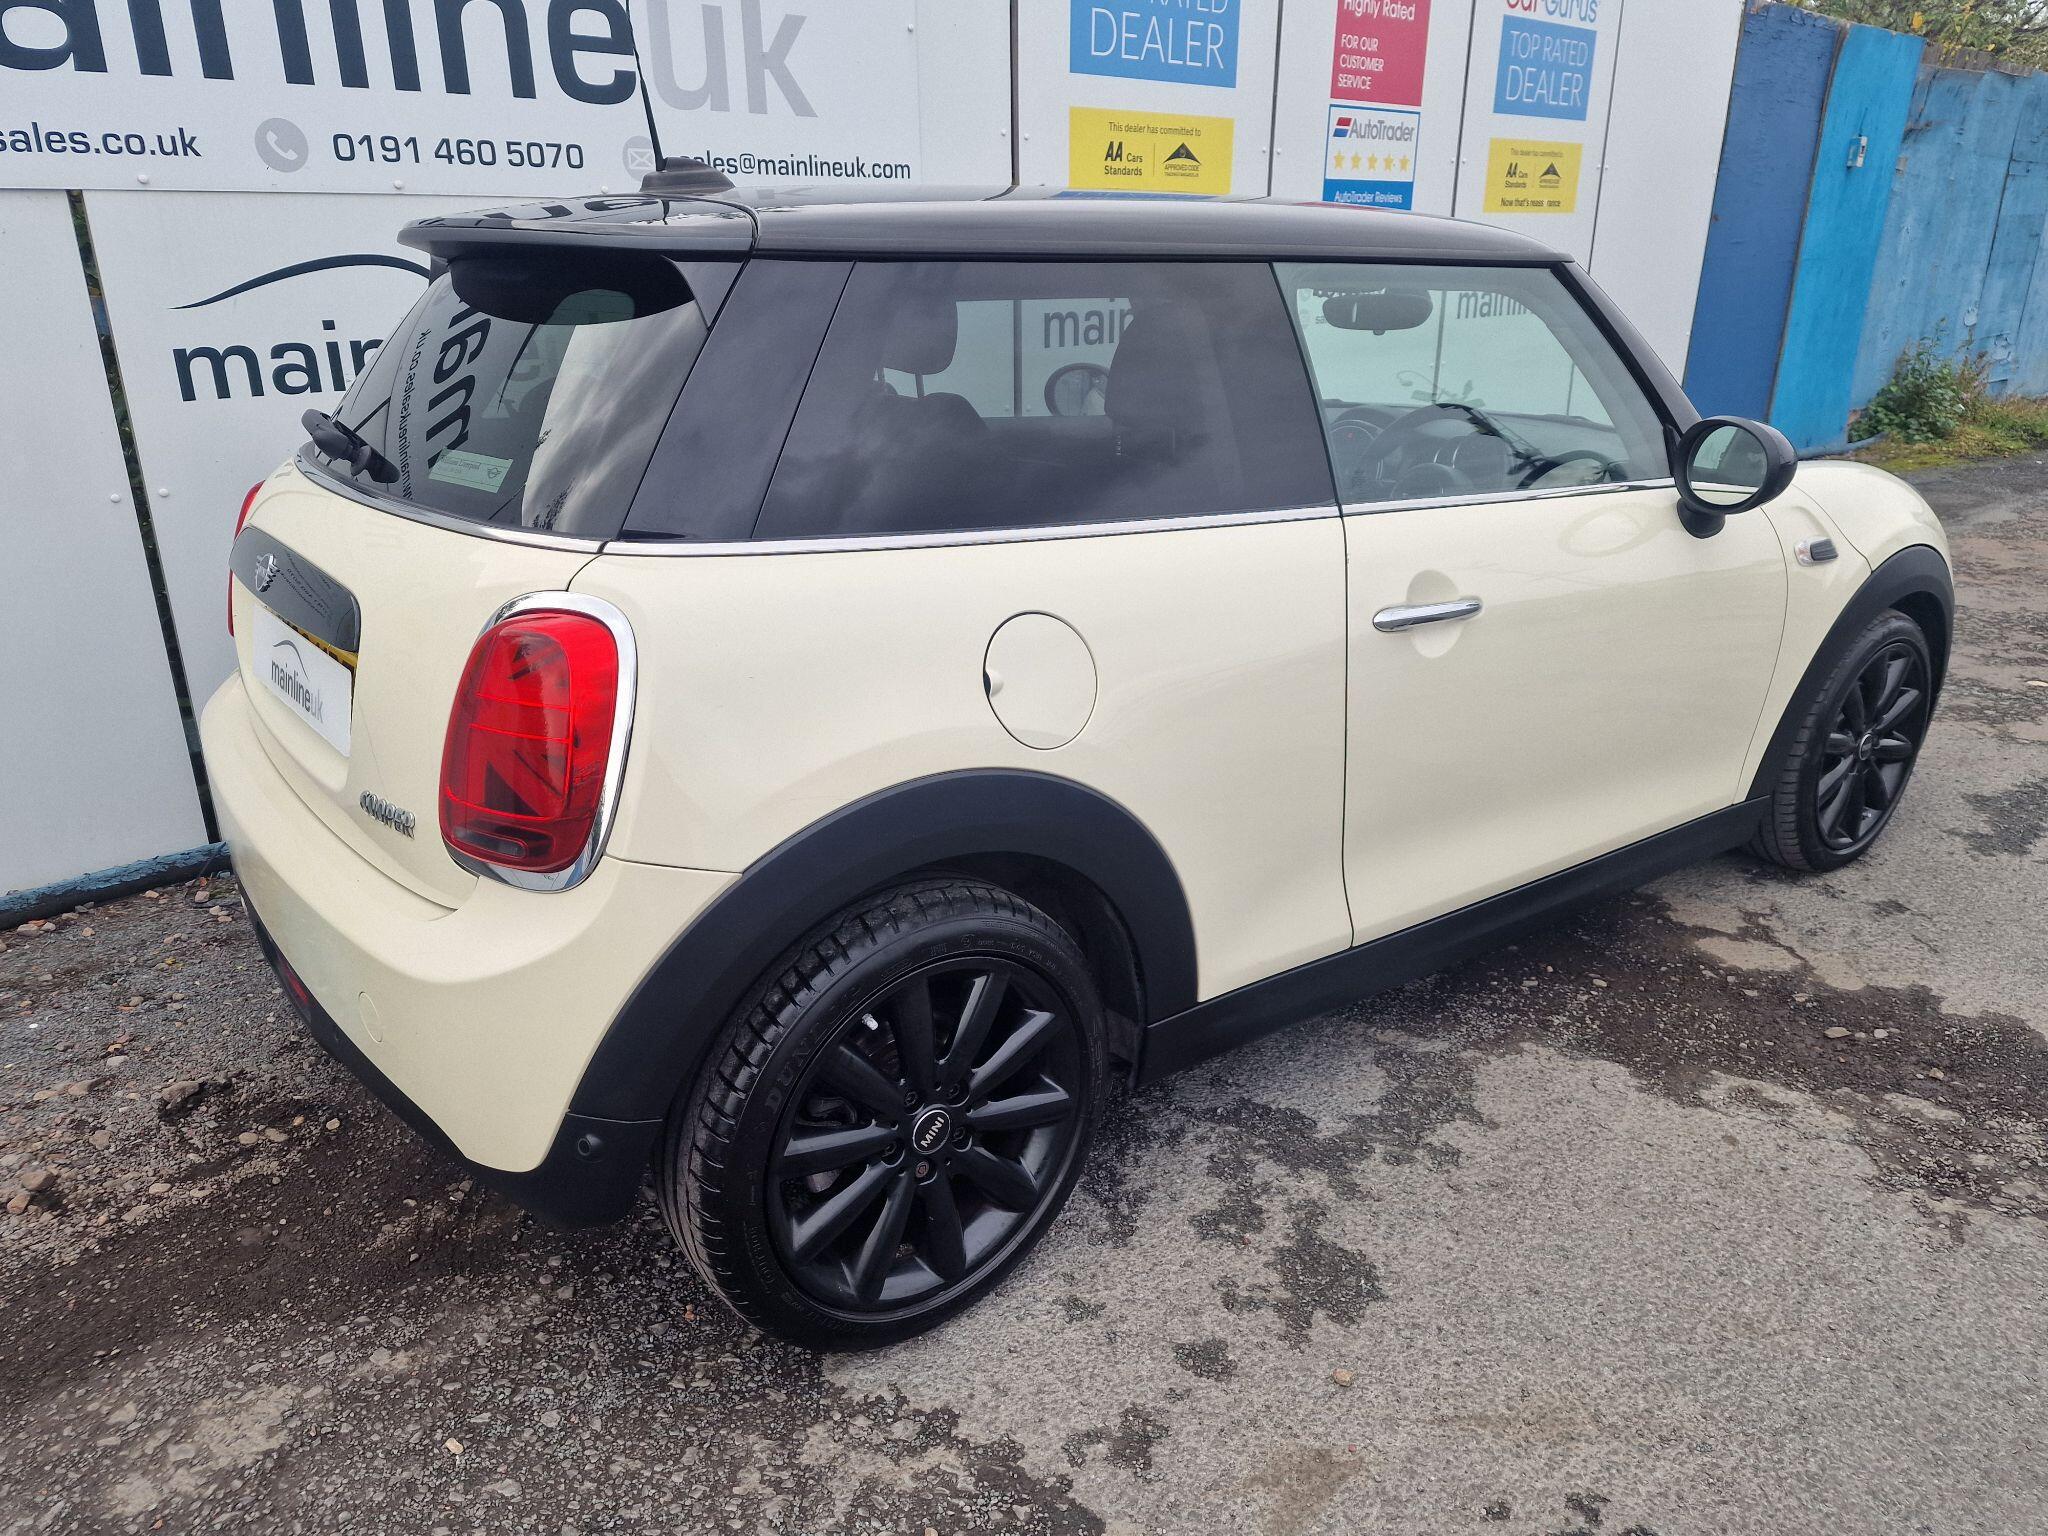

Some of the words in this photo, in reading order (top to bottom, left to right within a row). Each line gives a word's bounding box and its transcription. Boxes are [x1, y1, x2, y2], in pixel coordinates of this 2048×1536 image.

[1383, 0, 1415, 20] Rated
[1091, 7, 1225, 70] DEALER
[1341, 33, 1359, 50] FOR
[1361, 37, 1379, 52] OUR
[1510, 30, 1541, 60] TOP
[1542, 36, 1589, 67] RATED
[1339, 53, 1385, 73] CUSTOMER
[1337, 73, 1373, 90] SERVICE
[1505, 65, 1584, 107] DEALER
[1109, 121, 1123, 132] This
[1124, 123, 1146, 134] dealer
[1147, 124, 1159, 134] has
[1160, 126, 1194, 137] committed
[1194, 128, 1202, 137] to
[1349, 117, 1415, 142] AutoTrader
[333, 132, 421, 164] 0191
[434, 136, 497, 167] 460
[507, 141, 584, 170] 5070
[680, 149, 912, 181] les@mainlineuk.com
[1104, 140, 1123, 162] AA
[1126, 152, 1143, 163] Cars
[1104, 165, 1143, 177] Standards
[271, 658, 324, 724] mainlineuk
[360, 790, 415, 839] COOPER
[920, 1116, 945, 1148] MINI
